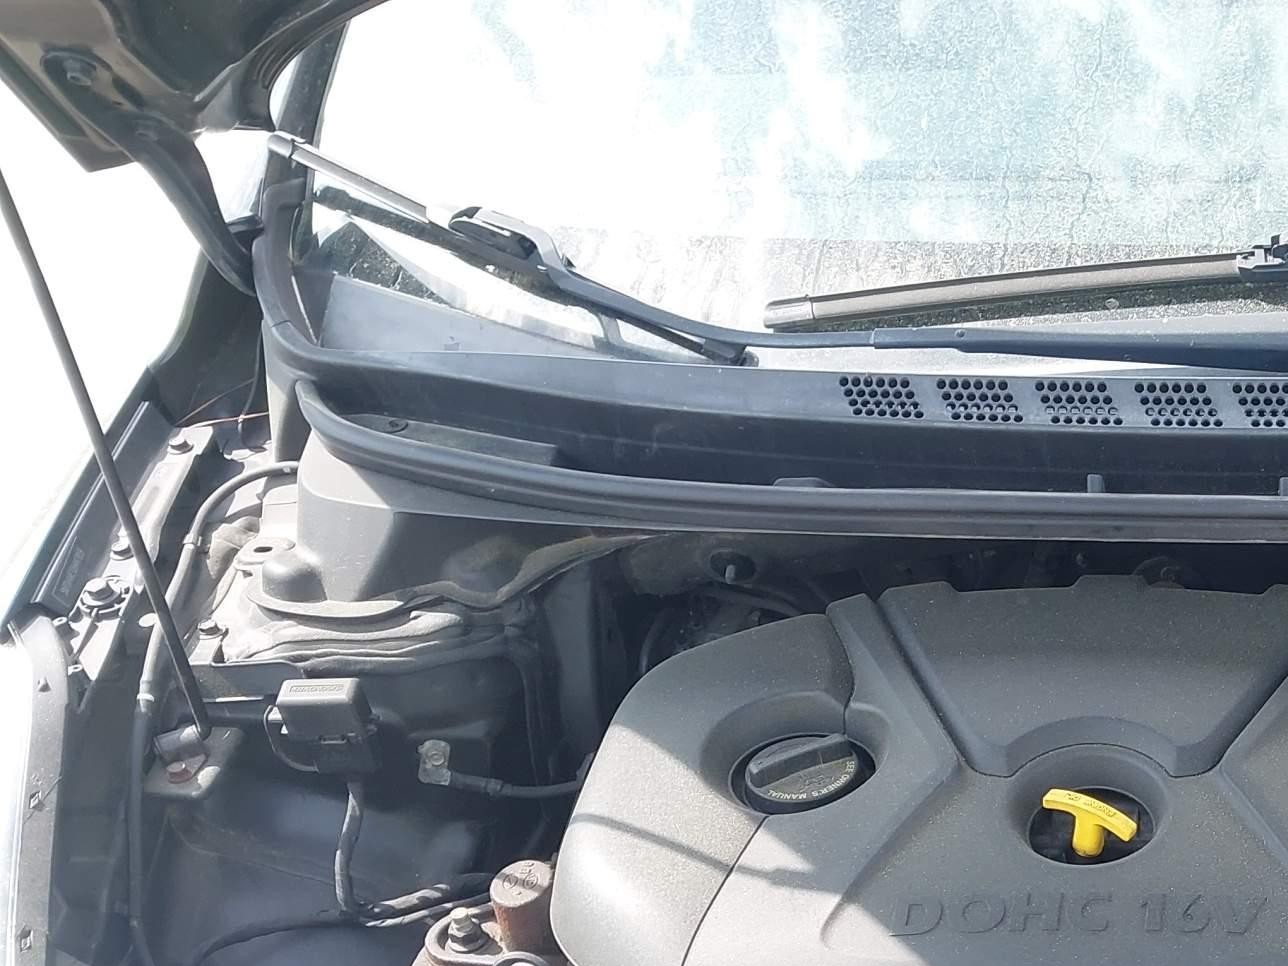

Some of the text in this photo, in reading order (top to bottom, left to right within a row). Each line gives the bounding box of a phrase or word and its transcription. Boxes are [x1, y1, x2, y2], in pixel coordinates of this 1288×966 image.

[846, 760, 856, 773] SEE
[767, 789, 807, 800] MANUAL
[888, 892, 1269, 936] DOHC 16V
